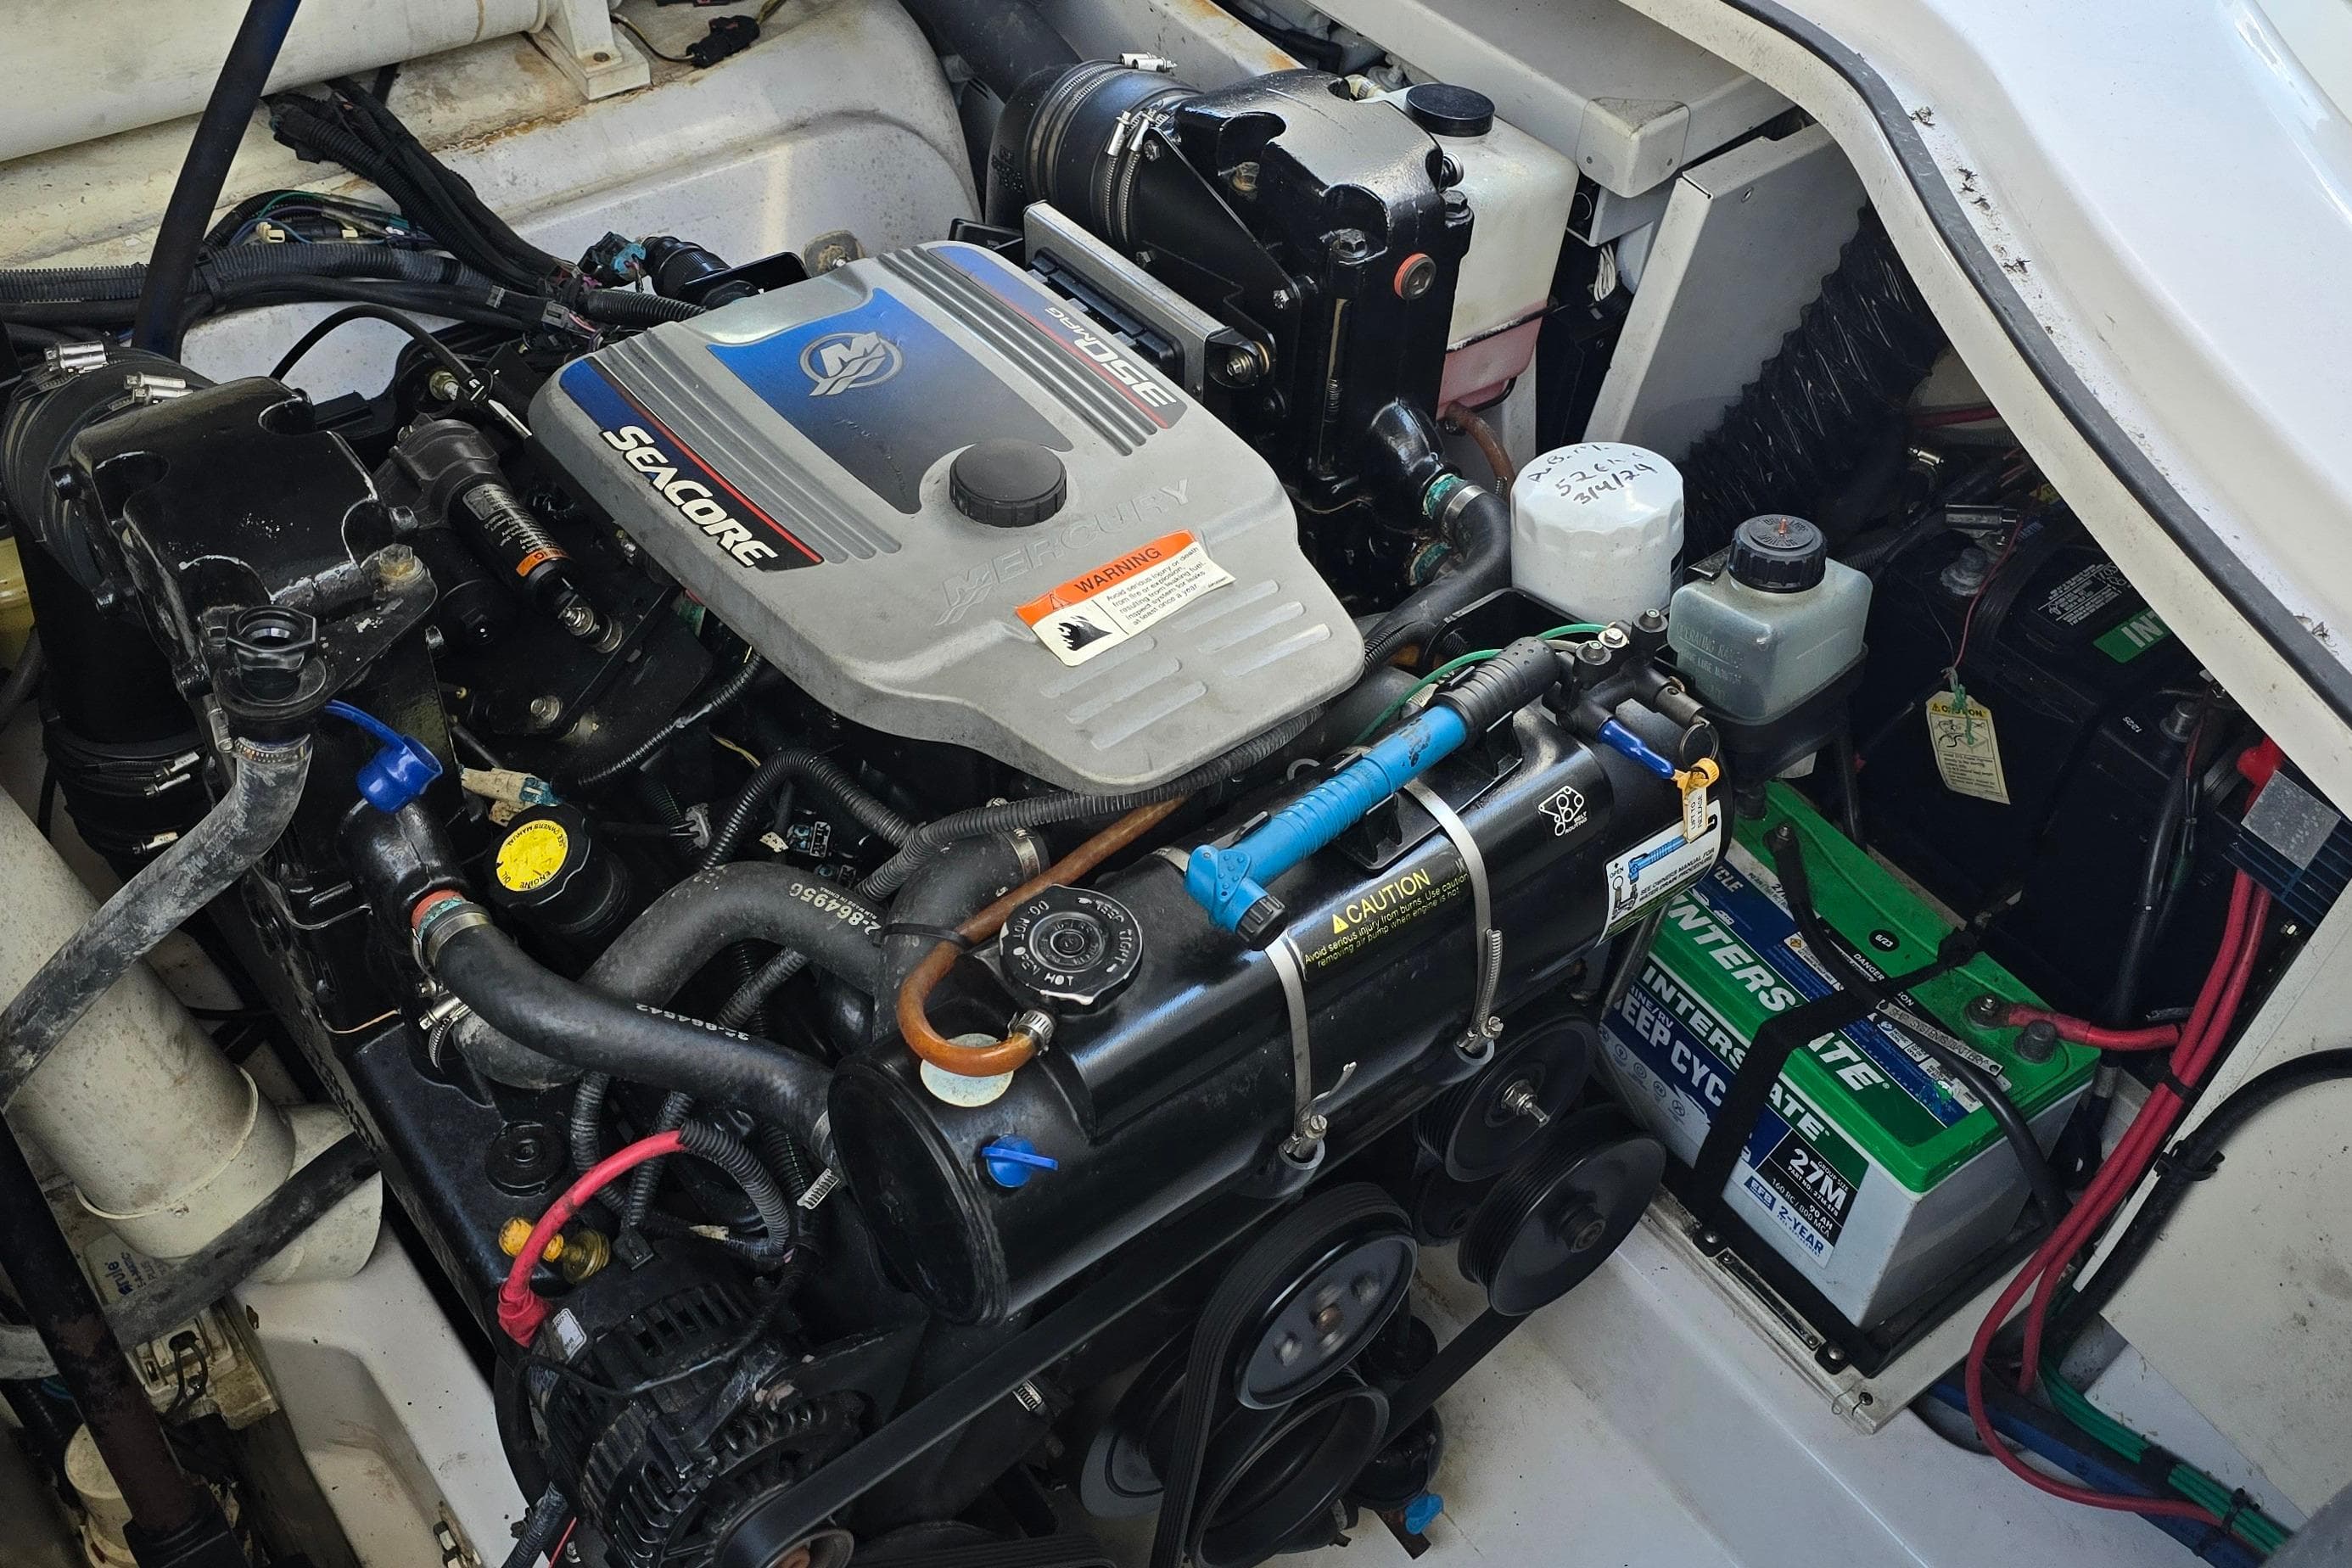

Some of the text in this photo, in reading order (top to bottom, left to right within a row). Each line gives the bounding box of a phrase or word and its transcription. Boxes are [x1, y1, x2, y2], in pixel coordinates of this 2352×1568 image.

[1044, 306, 1177, 407] 350 MAG
[600, 425, 779, 568] SEACORE
[1574, 463, 1658, 505] 3/4/24
[934, 479, 1188, 626] MERCURY
[1073, 547, 1162, 593] WARNING
[1106, 546, 1199, 601] Avoid serious injury or death
[1112, 596, 1129, 608] from
[1129, 590, 1142, 601] fire
[1120, 596, 1150, 615] resulting
[1150, 588, 1165, 599] from
[1165, 574, 1189, 592] leaking
[1151, 590, 1176, 608] system
[1941, 705, 1983, 717] CUON
[1573, 811, 1588, 823] BELT
[1690, 801, 1696, 814] TO
[507, 826, 533, 846] MANUAL
[1565, 818, 1588, 835] ROUTING
[501, 871, 512, 883] OIL
[519, 871, 552, 889] ENGINE
[1610, 866, 1624, 879] OPEN
[1639, 855, 1714, 903] WATER DRAIN PROCEDURE
[1640, 848, 1715, 896] SEE OWNERS MANUAL FOR
[819, 887, 840, 899] CHINA
[847, 899, 863, 914] MADE
[1346, 868, 1431, 925] CAUTION
[1304, 946, 1327, 965] Avoid
[1328, 931, 1358, 953] serious
[1358, 919, 1380, 939] injury
[1381, 908, 1400, 924] from
[1425, 886, 1441, 901] Use
[1442, 872, 1469, 893] caution
[1317, 944, 1354, 968] removing
[1356, 936, 1366, 949] air
[1367, 926, 1389, 946] pump
[1390, 912, 1411, 929] when
[1412, 898, 1437, 917] engine
[1013, 917, 1031, 940] NOT
[1044, 972, 1073, 986] HOT
[1853, 953, 1884, 981] DANGER
[1614, 992, 1672, 1047] EEP
[1889, 1008, 1909, 1022] SHIP
[1910, 1020, 1949, 1044] SYSTEMS
[1750, 1179, 1772, 1205] EFB
[1788, 1167, 1802, 1183] PART
[1789, 1148, 1847, 1211] 27M
[1817, 1161, 1849, 1191] GROUP SIZE
[1771, 1178, 1784, 1194] 160
[1784, 1190, 1795, 1204] RC
[1814, 1219, 1829, 1237] MCA
[1809, 1205, 1833, 1230] 90 AH
[1778, 1206, 1824, 1255] 2-YEAR
